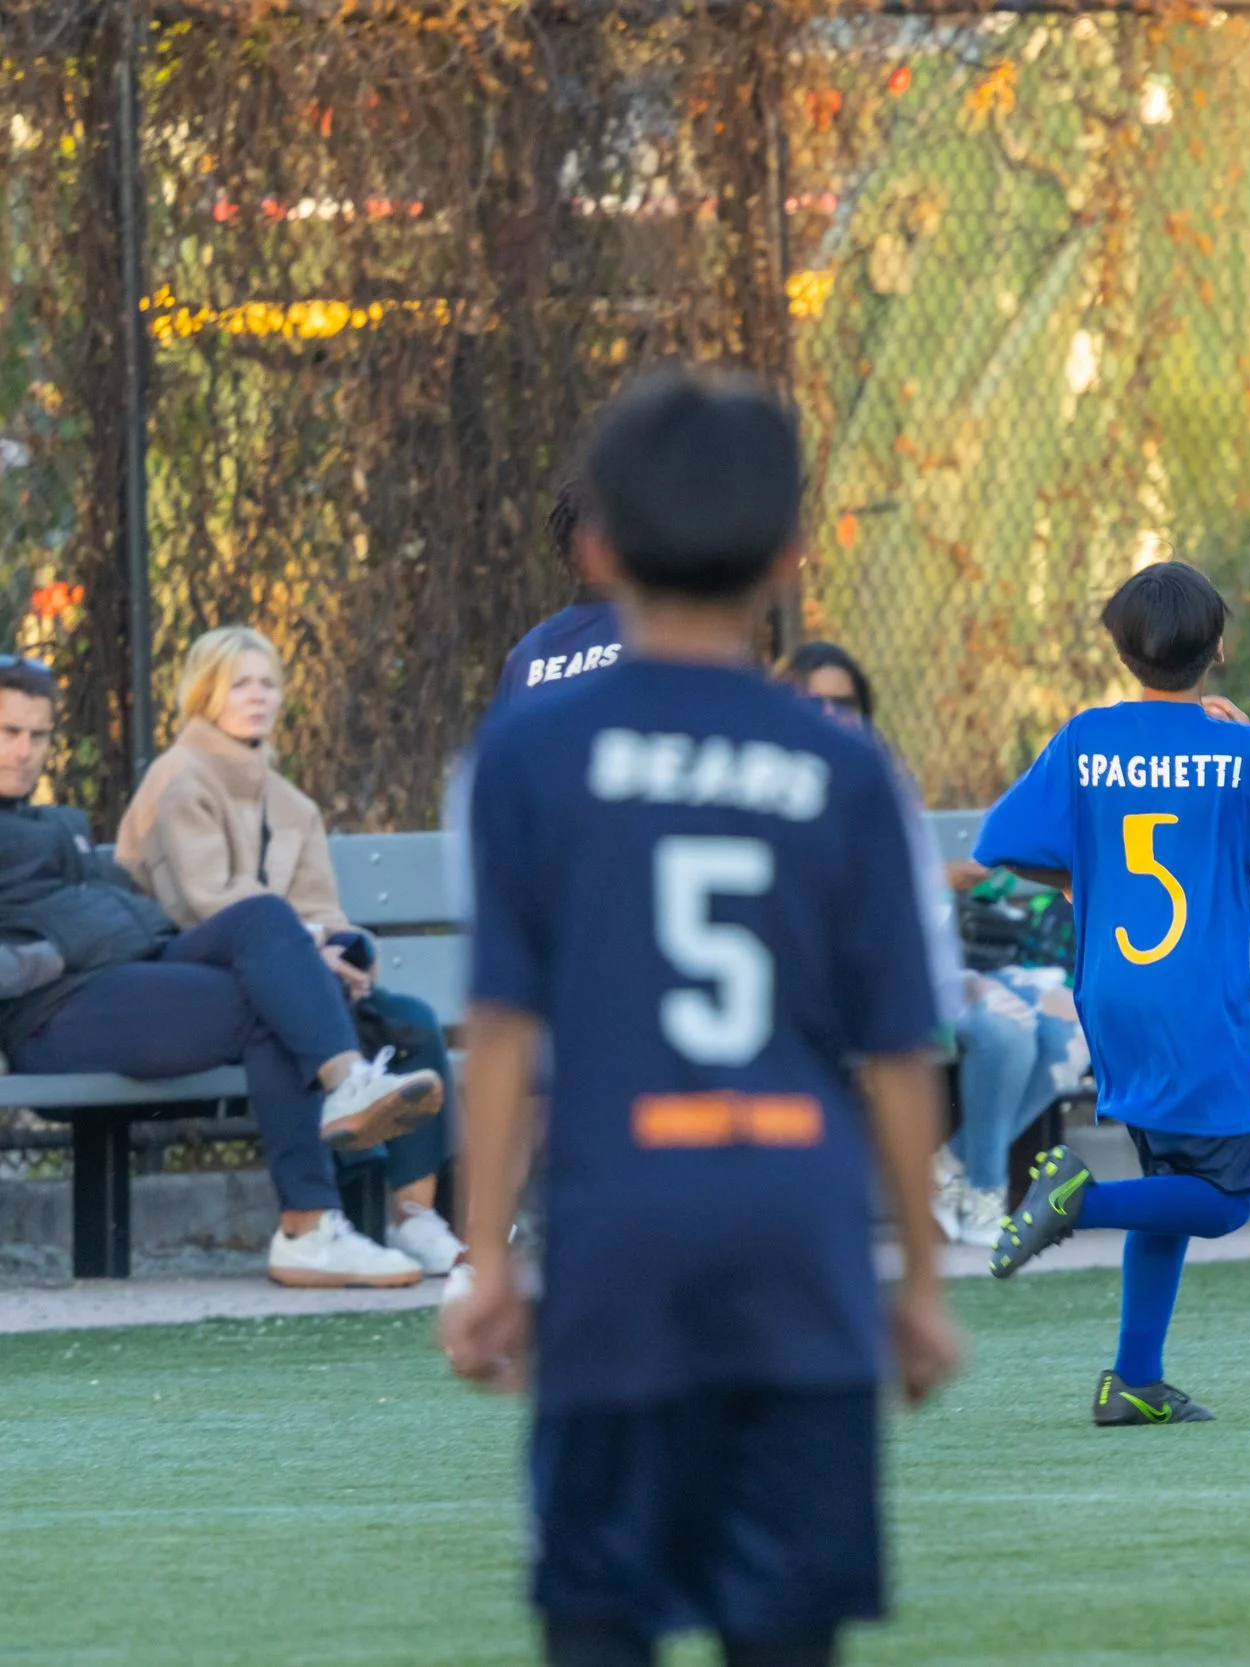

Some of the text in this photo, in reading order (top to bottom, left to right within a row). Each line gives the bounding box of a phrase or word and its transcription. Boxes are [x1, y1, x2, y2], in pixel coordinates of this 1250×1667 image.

[526, 643, 622, 687] BEARS
[588, 727, 830, 822] BEARS
[1078, 754, 1243, 788] SPAGHETTI
[1115, 813, 1188, 965] 5
[653, 834, 775, 1067] 5
